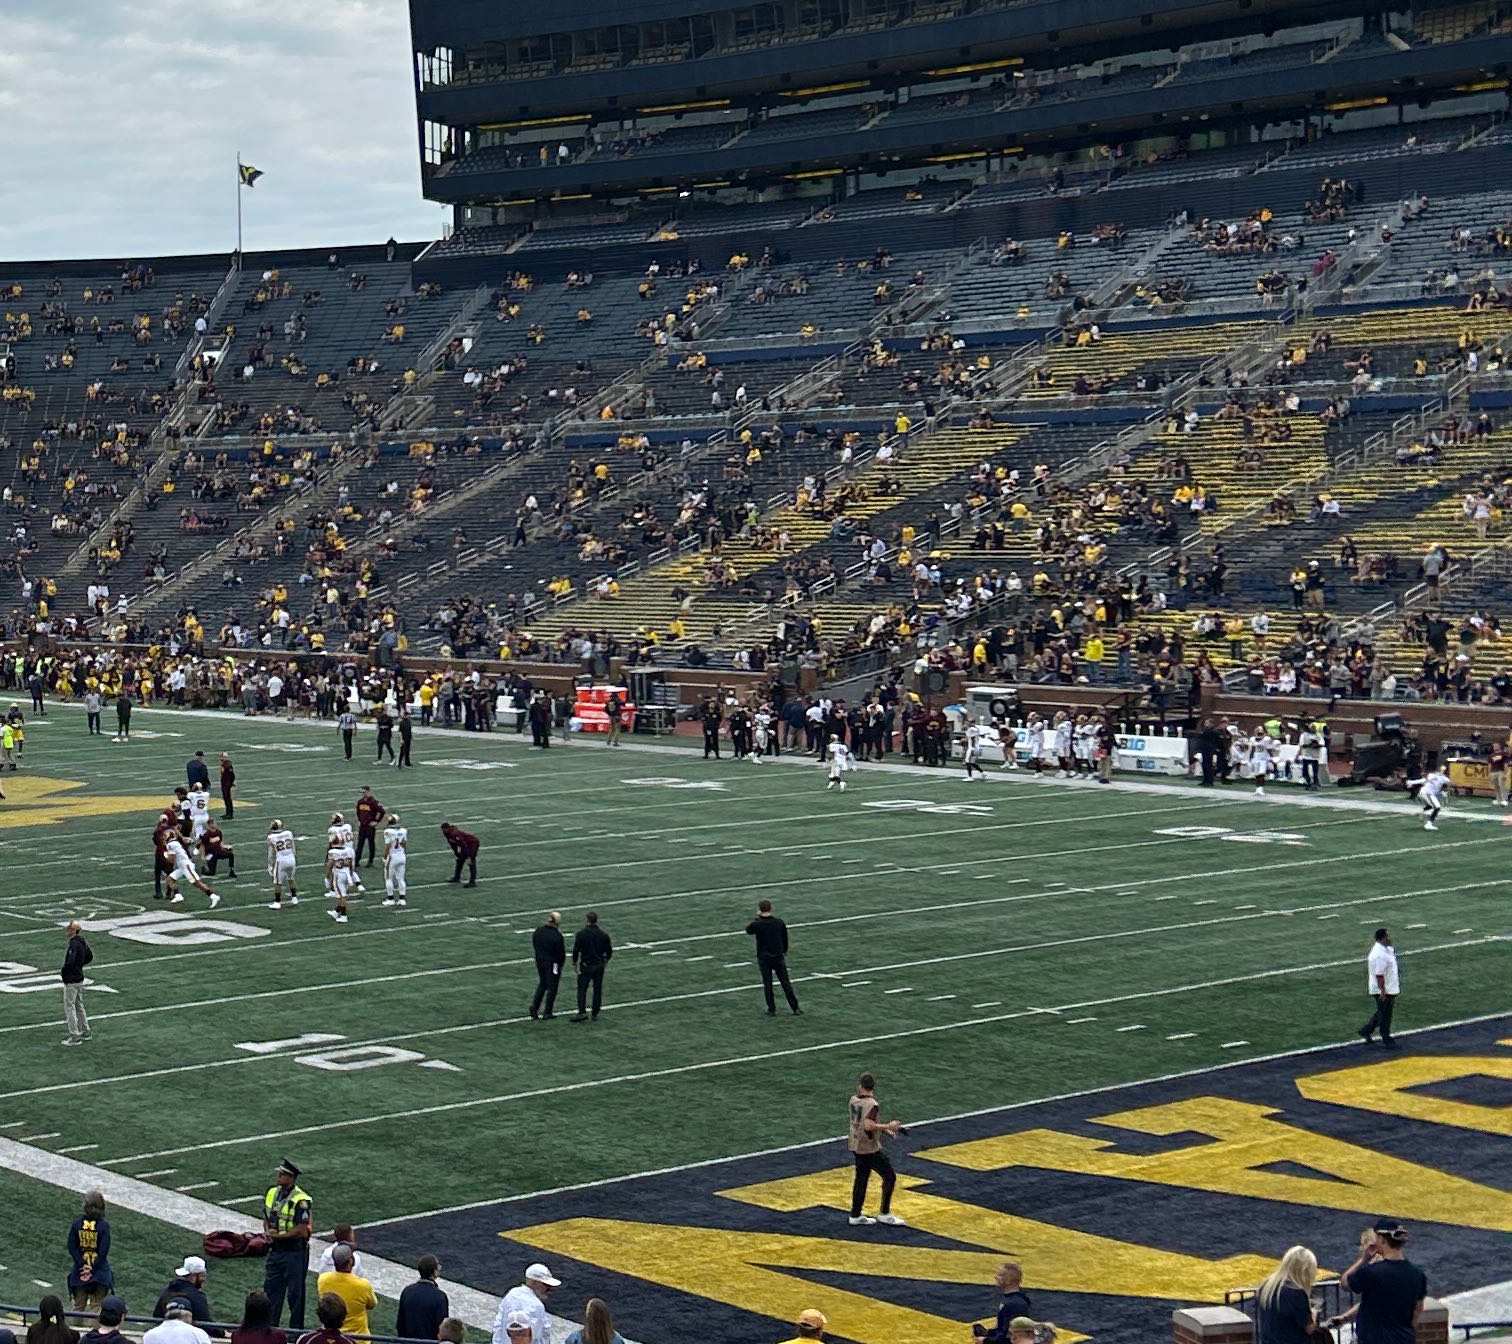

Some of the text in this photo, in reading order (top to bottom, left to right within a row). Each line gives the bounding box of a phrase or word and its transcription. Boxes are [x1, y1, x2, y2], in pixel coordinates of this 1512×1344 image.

[197, 800, 205, 809] 6
[234, 1032, 426, 1071] 10
[83, 1219, 96, 1231] M
